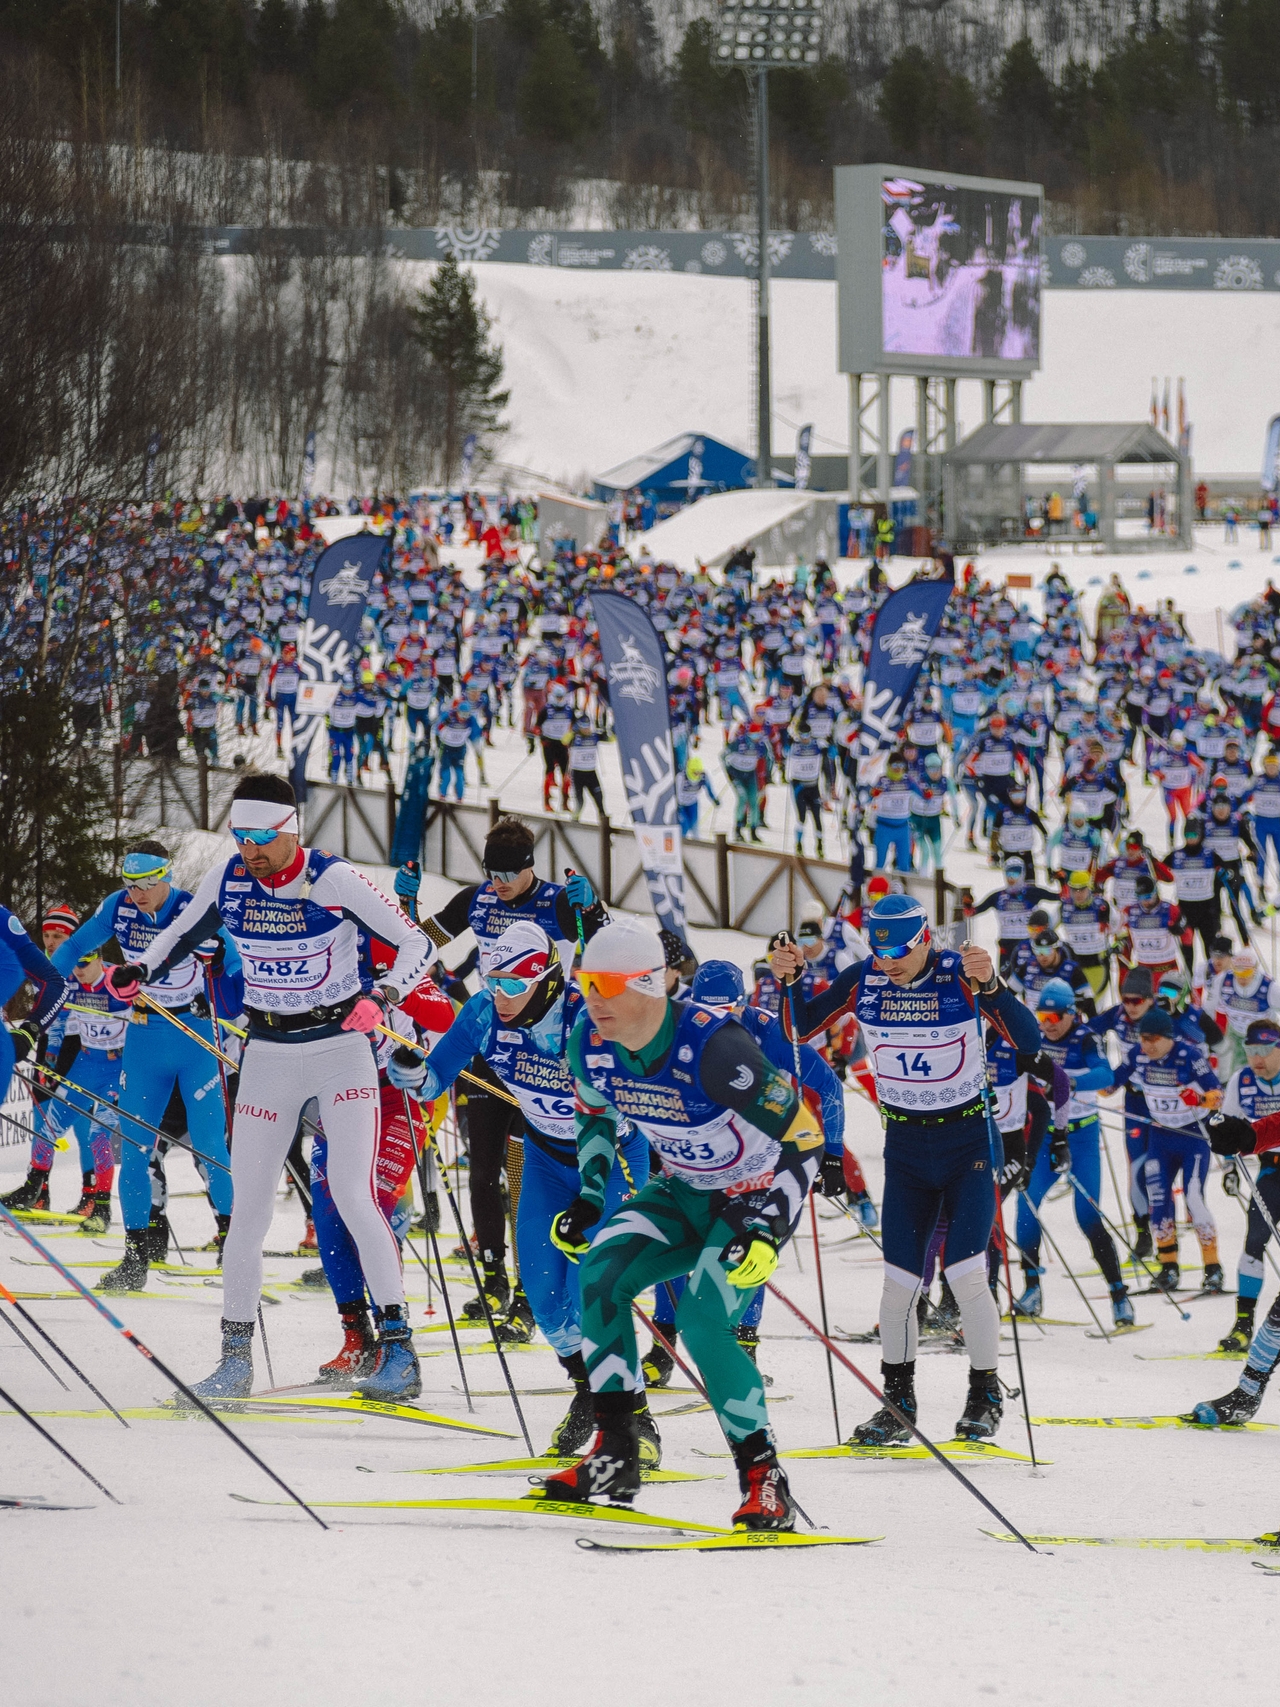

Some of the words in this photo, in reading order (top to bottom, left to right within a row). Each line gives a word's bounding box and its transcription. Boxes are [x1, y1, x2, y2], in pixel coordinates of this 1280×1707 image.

[245, 898, 266, 908] 50-Й
[243, 908, 304, 923] ЛЫЖНЫЙ
[489, 907, 506, 916] 50-Й
[242, 921, 307, 934] МАРАФОН
[248, 959, 309, 977] 1482
[289, 972, 323, 984] АЛЕКСЕЙ
[881, 990, 901, 998] 50-Й
[881, 998, 939, 1011] ЛЫЖНЫЙ
[880, 1011, 939, 1021] МАРАФОН
[84, 1022, 111, 1037] 154
[516, 1051, 539, 1062] 50-Й
[896, 1052, 932, 1077] 14
[611, 1076, 634, 1088] 50-Й
[634, 1082, 681, 1097] МУРМАНСКИЙ
[531, 1097, 574, 1116] 16
[614, 1089, 685, 1111] ЛЫЖНЫЙ
[617, 1103, 691, 1123] МАРАФОН
[361, 1400, 398, 1414] FISCHER
[758, 1469, 780, 1512] alpina
[533, 1501, 595, 1516] FISCHER
[747, 1534, 779, 1543] FISCHER
